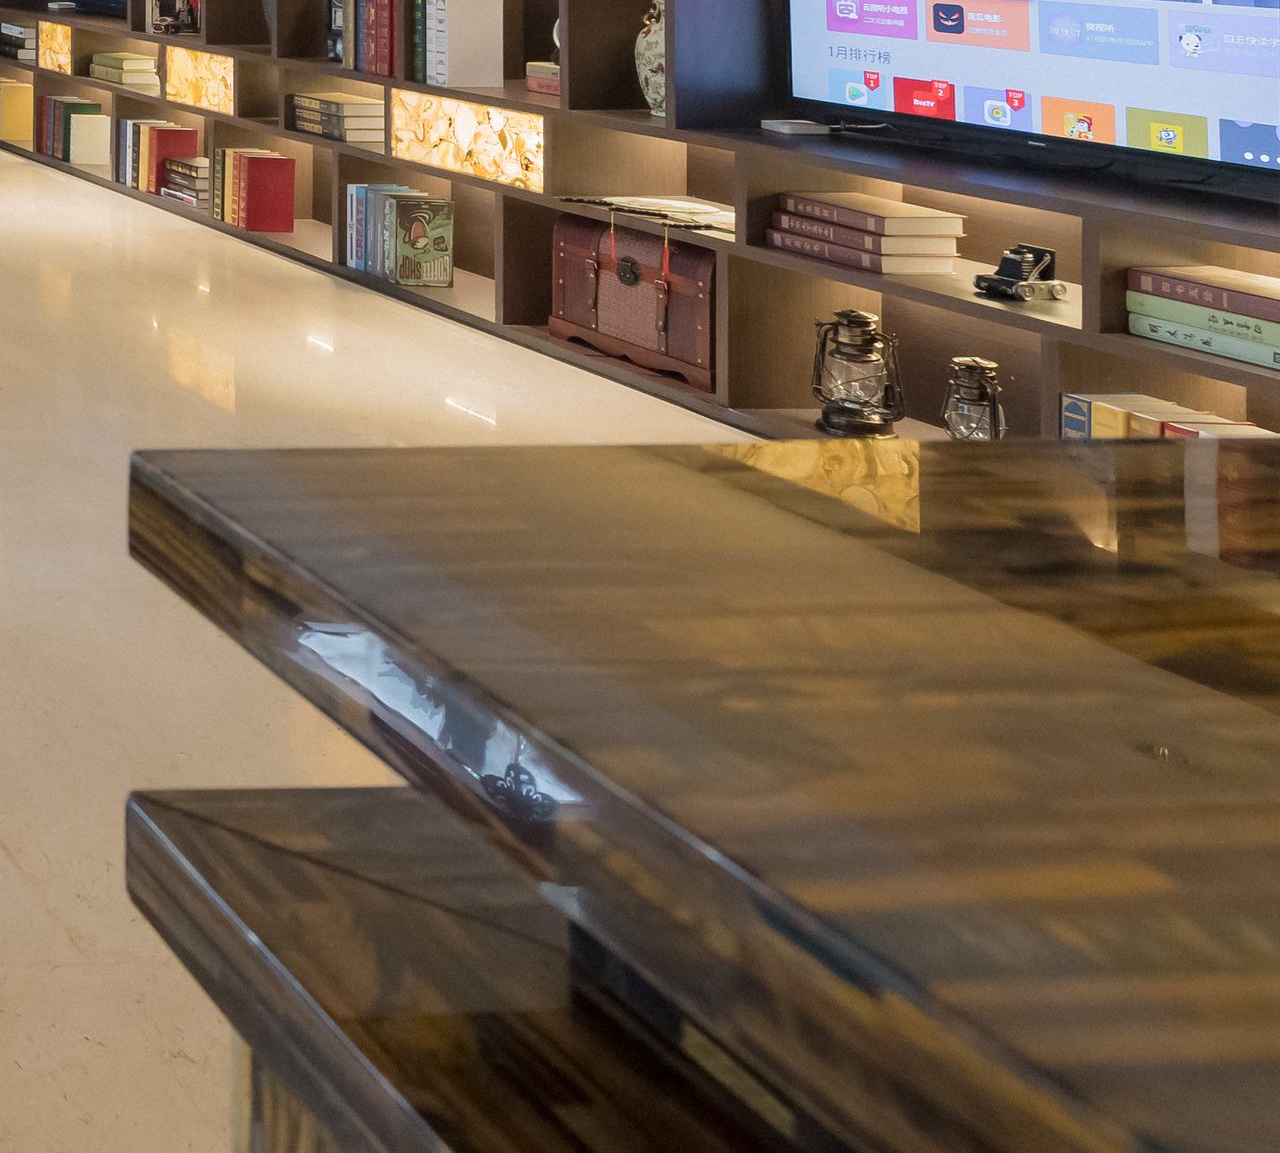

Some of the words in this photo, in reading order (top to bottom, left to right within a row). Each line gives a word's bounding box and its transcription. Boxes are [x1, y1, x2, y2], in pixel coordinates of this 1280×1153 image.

[863, 3, 908, 15] 云视听小电视
[967, 12, 1002, 23] 南瓜电影
[828, 46, 891, 65] 1月排行榜
[938, 89, 944, 97] 2
[1012, 99, 1019, 107] 3
[355, 197, 364, 261] CREATE
[400, 253, 422, 280] SHOP
[422, 255, 449, 281] COFFEE
